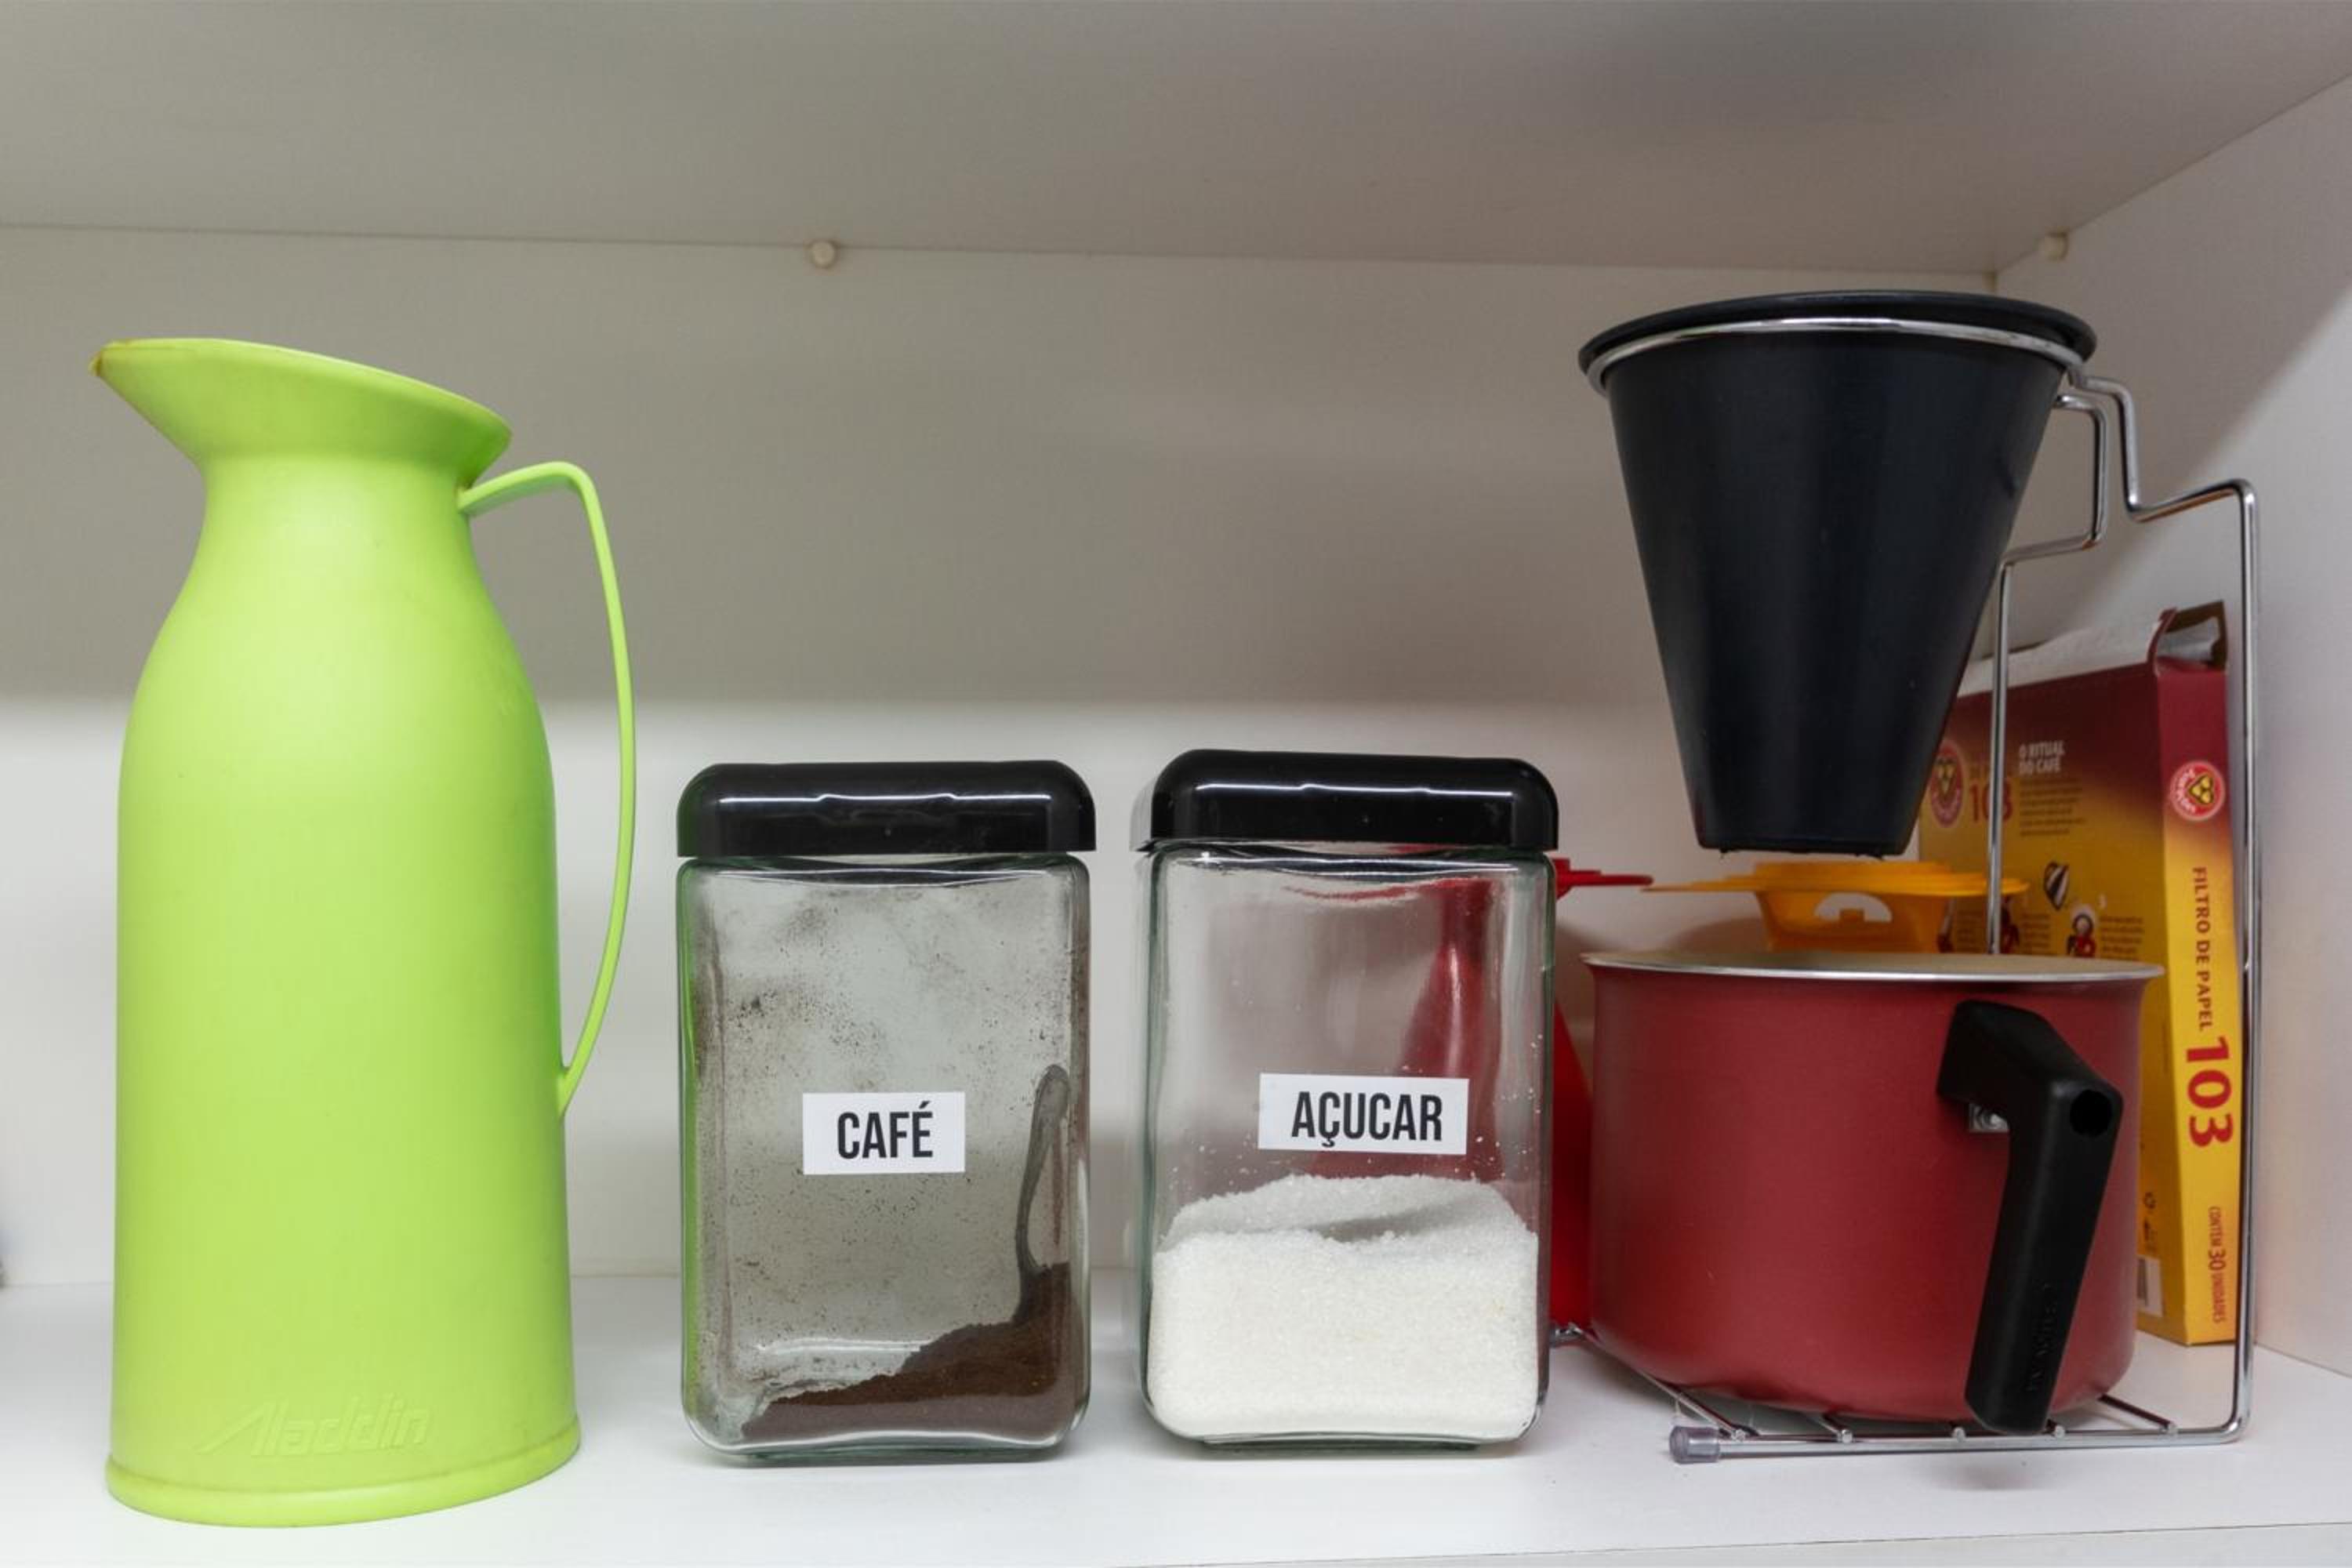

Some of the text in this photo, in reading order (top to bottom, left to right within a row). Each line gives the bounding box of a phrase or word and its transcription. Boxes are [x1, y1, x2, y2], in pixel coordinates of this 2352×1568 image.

[2185, 866, 2234, 1148] FILTRO DE PAPEL 103
[837, 1101, 934, 1159] CAFÉ
[1290, 1091, 1442, 1148] AÇUCAR
[2208, 1248, 2227, 1271] 30
[192, 1392, 433, 1458] Aladdin
